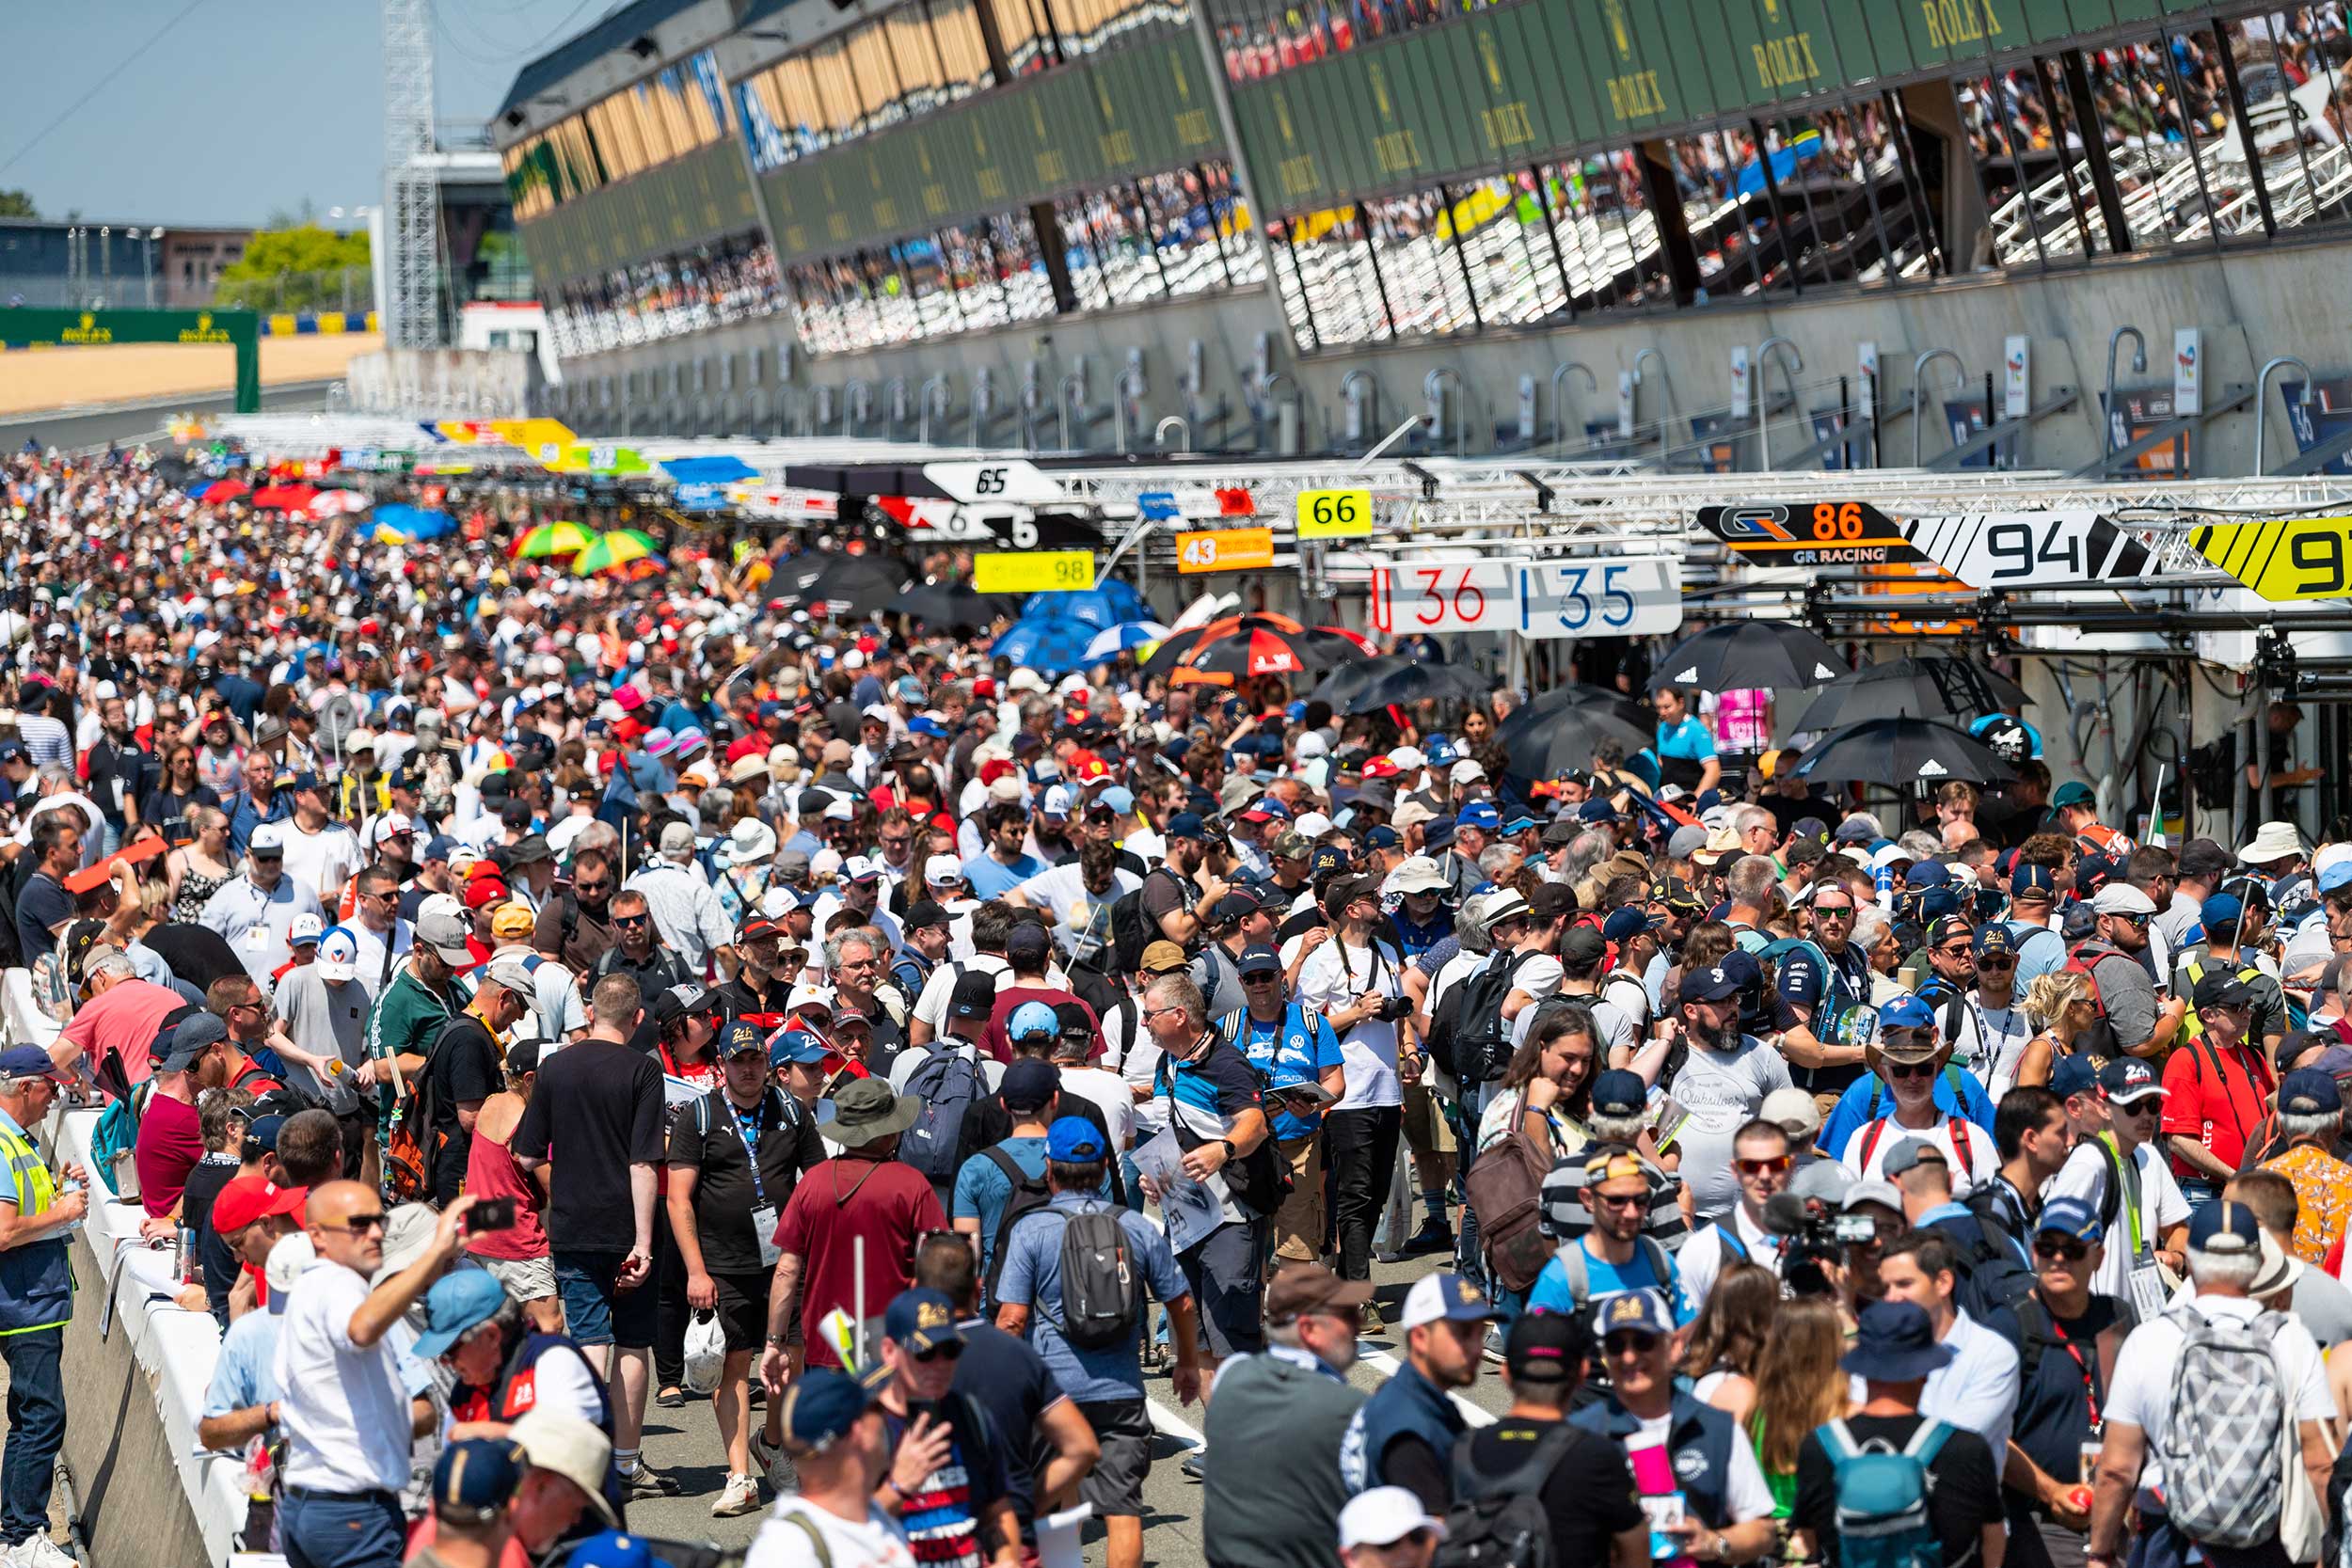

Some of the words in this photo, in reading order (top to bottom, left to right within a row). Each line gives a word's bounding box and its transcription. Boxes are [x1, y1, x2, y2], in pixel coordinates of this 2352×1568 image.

[1921, 2, 2002, 48] ROLEX
[1751, 32, 1821, 88] ROLEX
[976, 467, 1008, 494] 65
[1313, 496, 1356, 524] 66
[1813, 503, 1865, 541] 86
[1183, 540, 1217, 567] 43
[1793, 551, 1819, 564] GR
[1820, 548, 1884, 562] RACING
[1987, 521, 2080, 579] 94
[2291, 530, 2352, 595] 9
[1054, 560, 1085, 586] 98
[1417, 566, 1486, 626] 36
[1560, 564, 1638, 629] 35
[1985, 929, 2004, 942] 24h
[733, 1027, 754, 1039] 24h
[2125, 1065, 2151, 1081] 24h
[1681, 1088, 1745, 1108] Quiksilver
